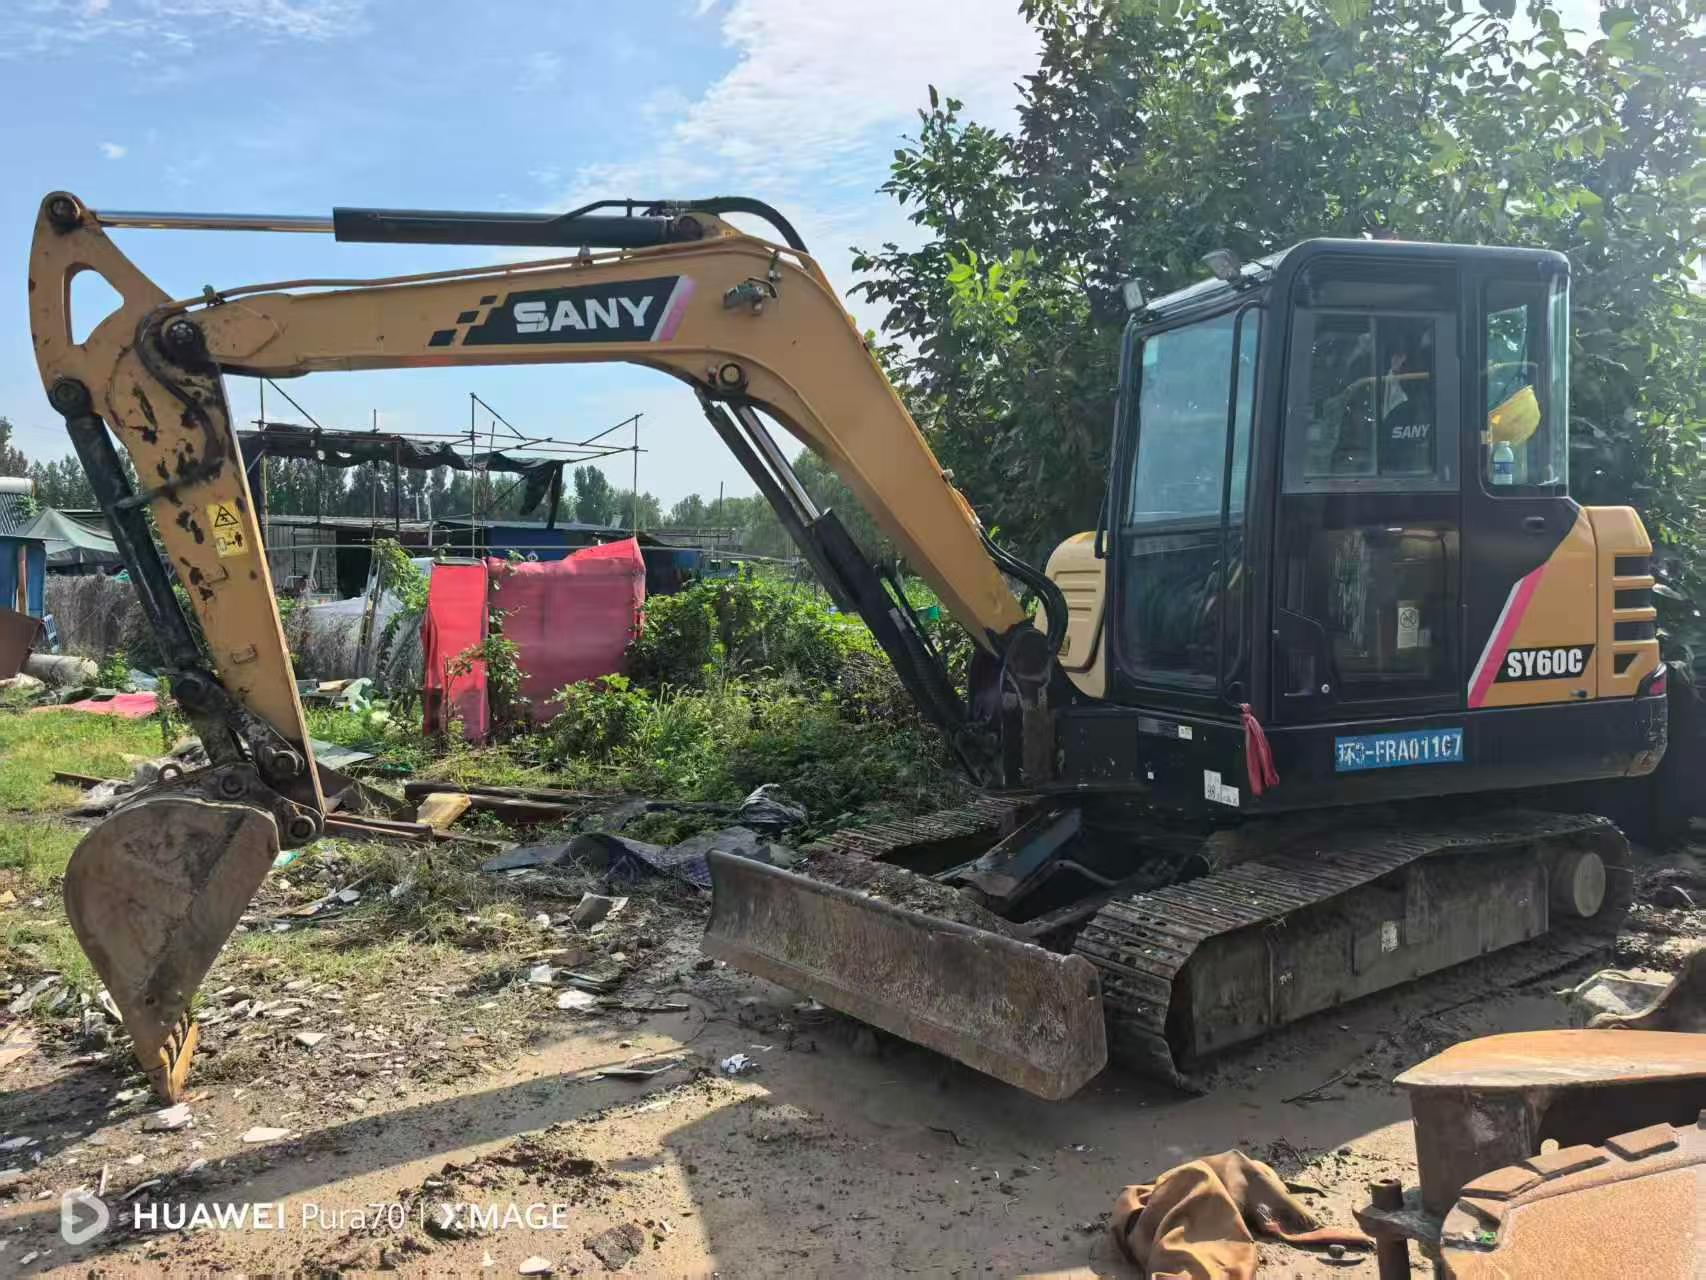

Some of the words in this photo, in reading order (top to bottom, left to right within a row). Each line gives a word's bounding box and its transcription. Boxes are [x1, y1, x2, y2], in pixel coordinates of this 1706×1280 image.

[513, 295, 654, 333] SANY
[1391, 423, 1431, 439] SANY
[1507, 648, 1583, 677] SY60C
